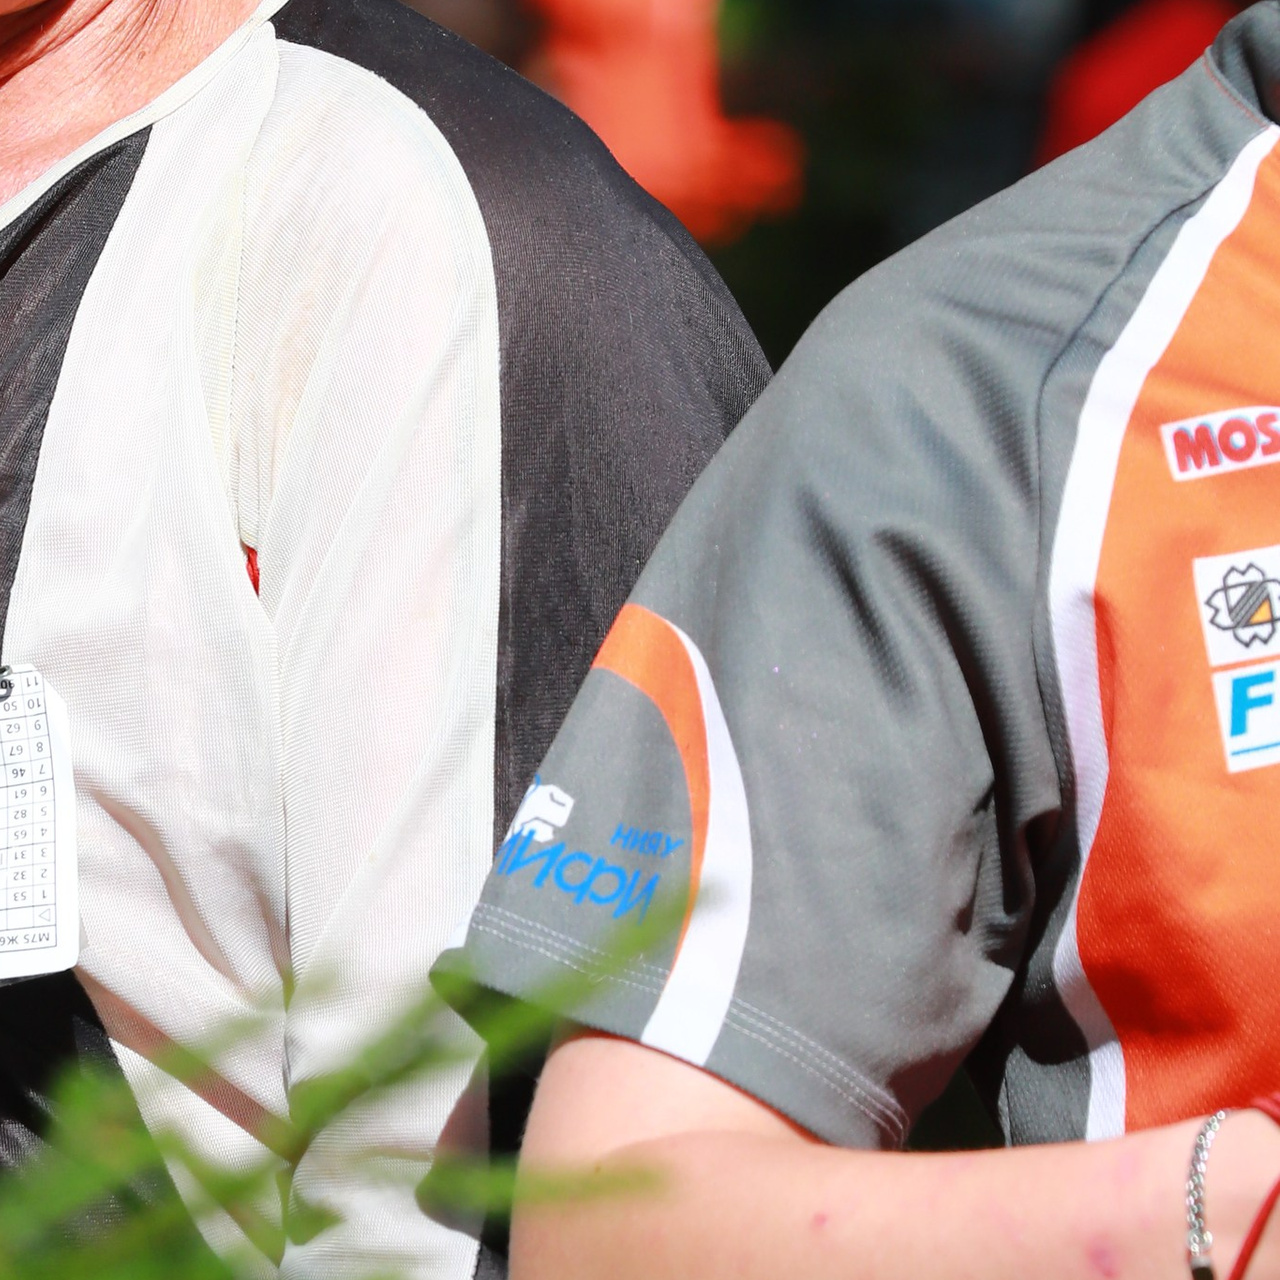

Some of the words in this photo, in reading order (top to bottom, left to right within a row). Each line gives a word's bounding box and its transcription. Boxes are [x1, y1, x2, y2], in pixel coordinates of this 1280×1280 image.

[1173, 413, 1280, 474] MOS
[26, 676, 39, 687] 11
[3, 700, 17, 712] 50
[27, 697, 41, 709] 10
[6, 723, 20, 734] 62
[34, 719, 41, 730] 9
[9, 745, 23, 756] 67
[36, 742, 43, 752] 8
[12, 768, 26, 778] 46
[39, 764, 45, 774] 7
[14, 789, 27, 799] 61
[40, 786, 47, 796] 6
[14, 809, 27, 819] 82
[41, 806, 47, 816] 5
[14, 830, 27, 840] 65
[41, 827, 47, 836] 4
[610, 823, 684, 858] НИЯУ
[14, 850, 26, 860] 31
[41, 847, 47, 858] 3
[13, 870, 26, 880] 32
[41, 868, 47, 878] 2
[13, 891, 27, 901] 53
[42, 889, 47, 899] 1
[24, 932, 50, 944] М75
